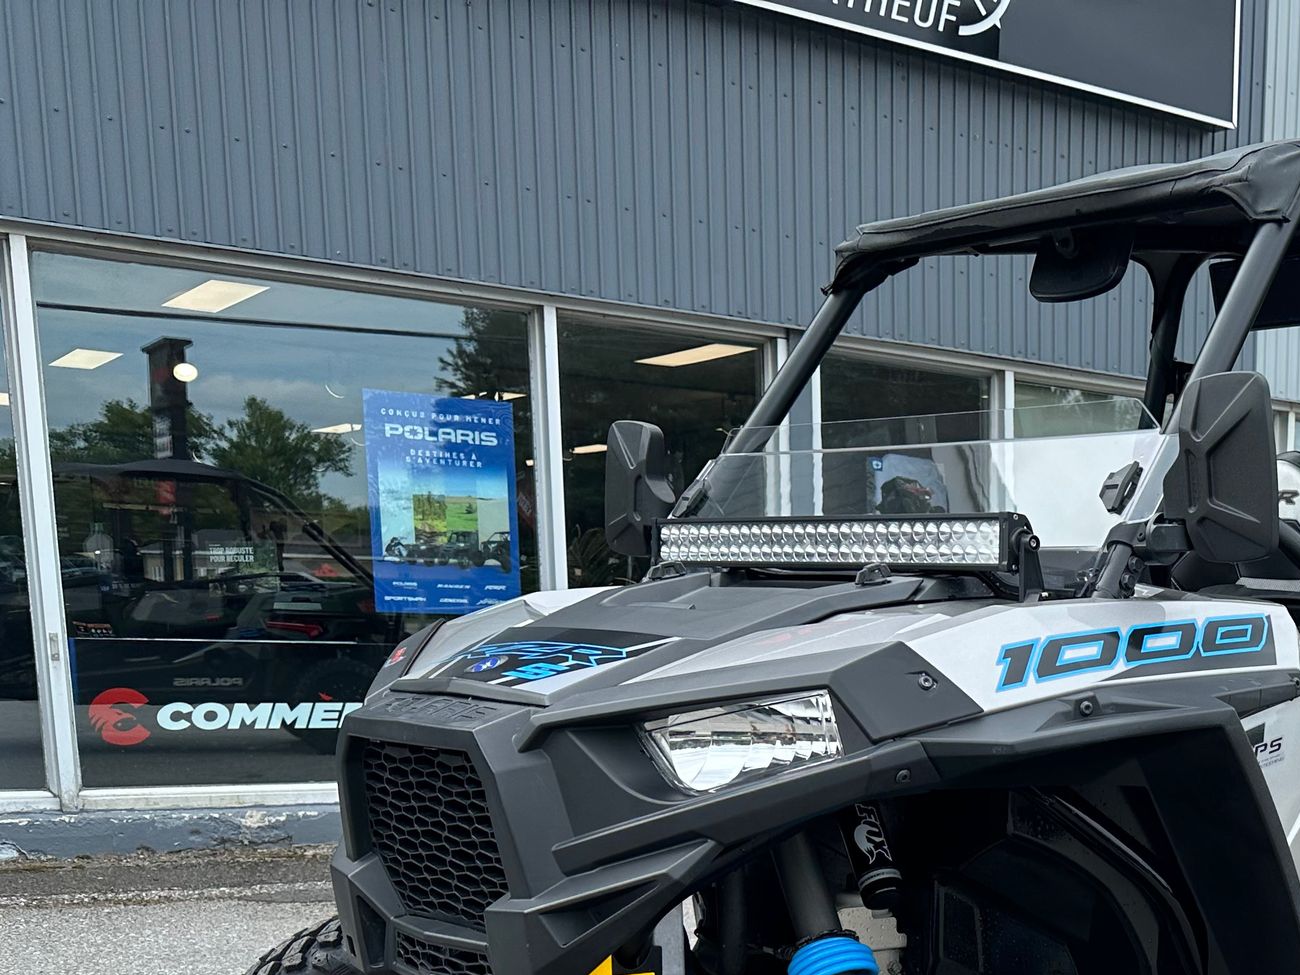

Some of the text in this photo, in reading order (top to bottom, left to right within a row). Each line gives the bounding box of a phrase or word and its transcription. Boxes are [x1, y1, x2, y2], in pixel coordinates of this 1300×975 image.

[384, 423, 498, 447] POLARIS
[431, 412, 460, 422] POUR
[465, 415, 501, 426] MENER
[996, 613, 1268, 693] 1000
[854, 803, 893, 865] FOX
